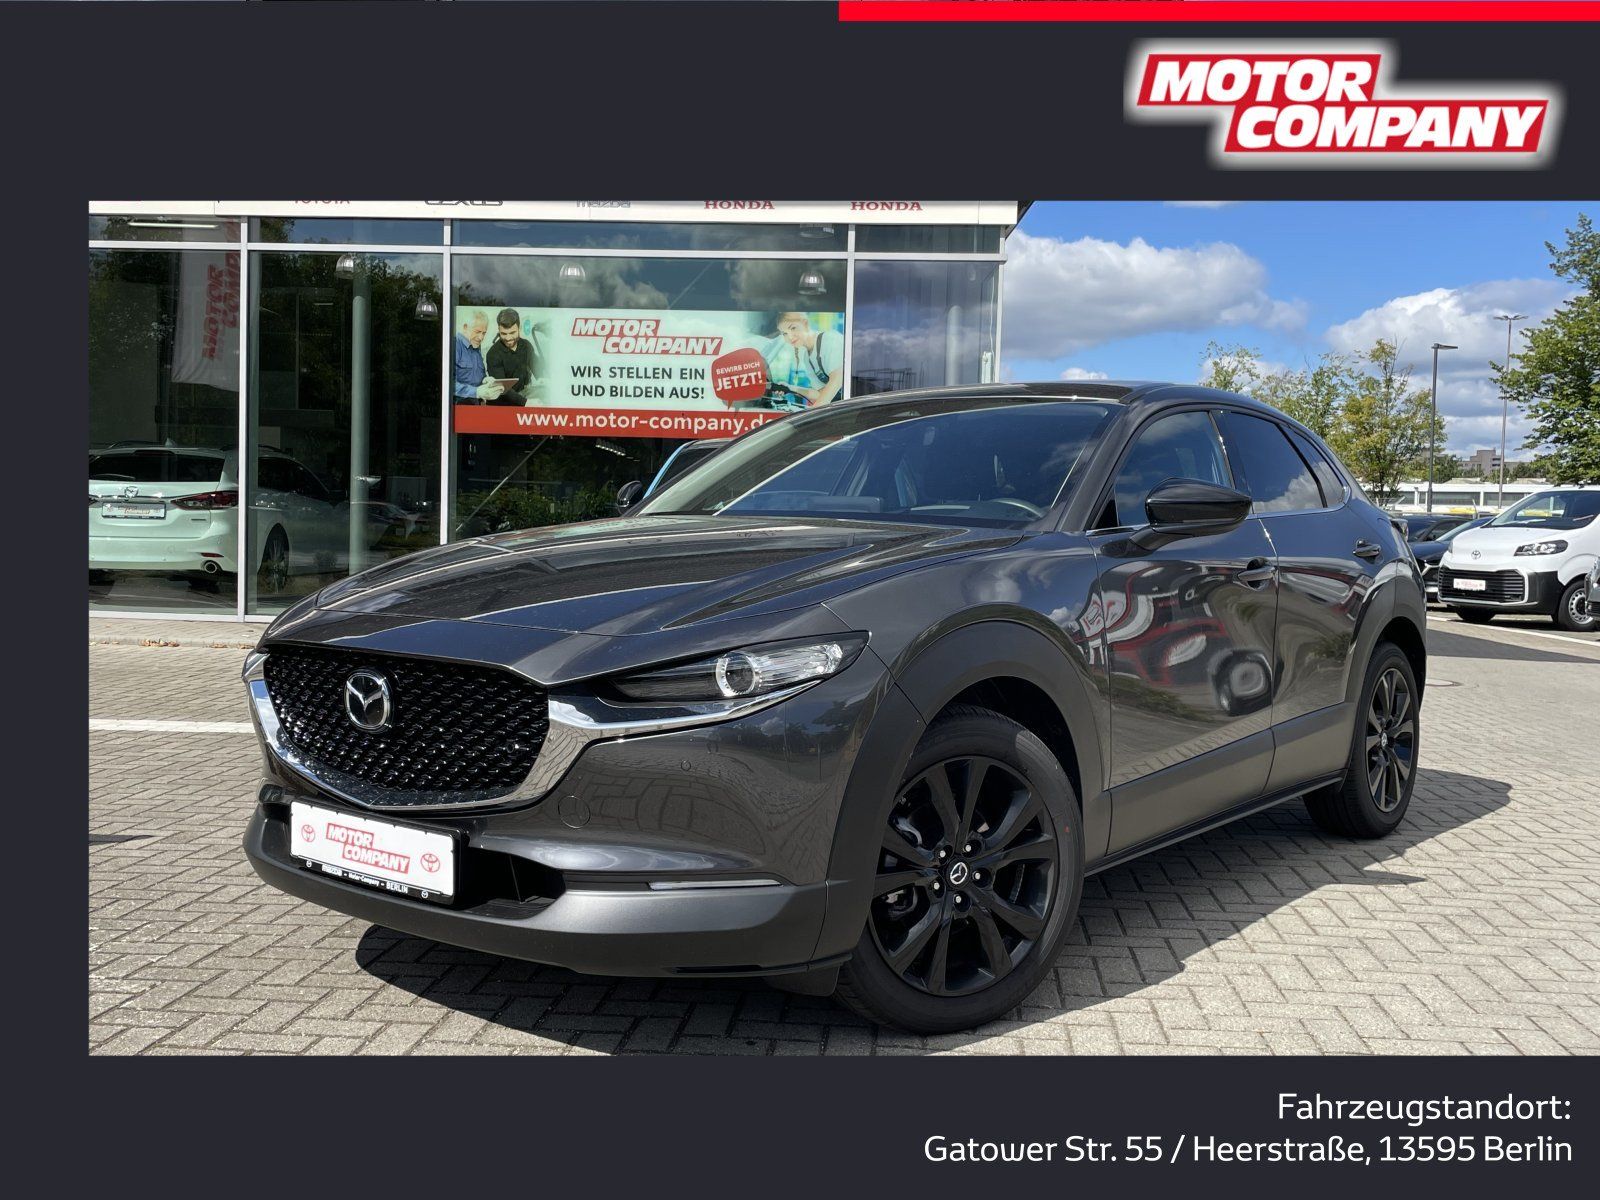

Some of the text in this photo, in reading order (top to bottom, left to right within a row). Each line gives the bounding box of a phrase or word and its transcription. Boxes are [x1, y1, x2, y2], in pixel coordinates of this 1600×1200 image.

[703, 200, 775, 210] HONDA
[850, 201, 923, 211] HONDA
[573, 318, 657, 337] MOTOR
[605, 336, 721, 355] COMPANY
[571, 366, 705, 381] WIR STELLEN EIN
[716, 361, 761, 375] BEWIRB DICH
[716, 371, 763, 391] JETZT!
[571, 385, 705, 400] UND BILDEN AUS!
[328, 824, 373, 848] MOTOR
[344, 842, 409, 873] COMPANY
[386, 881, 409, 894] BERLIN
